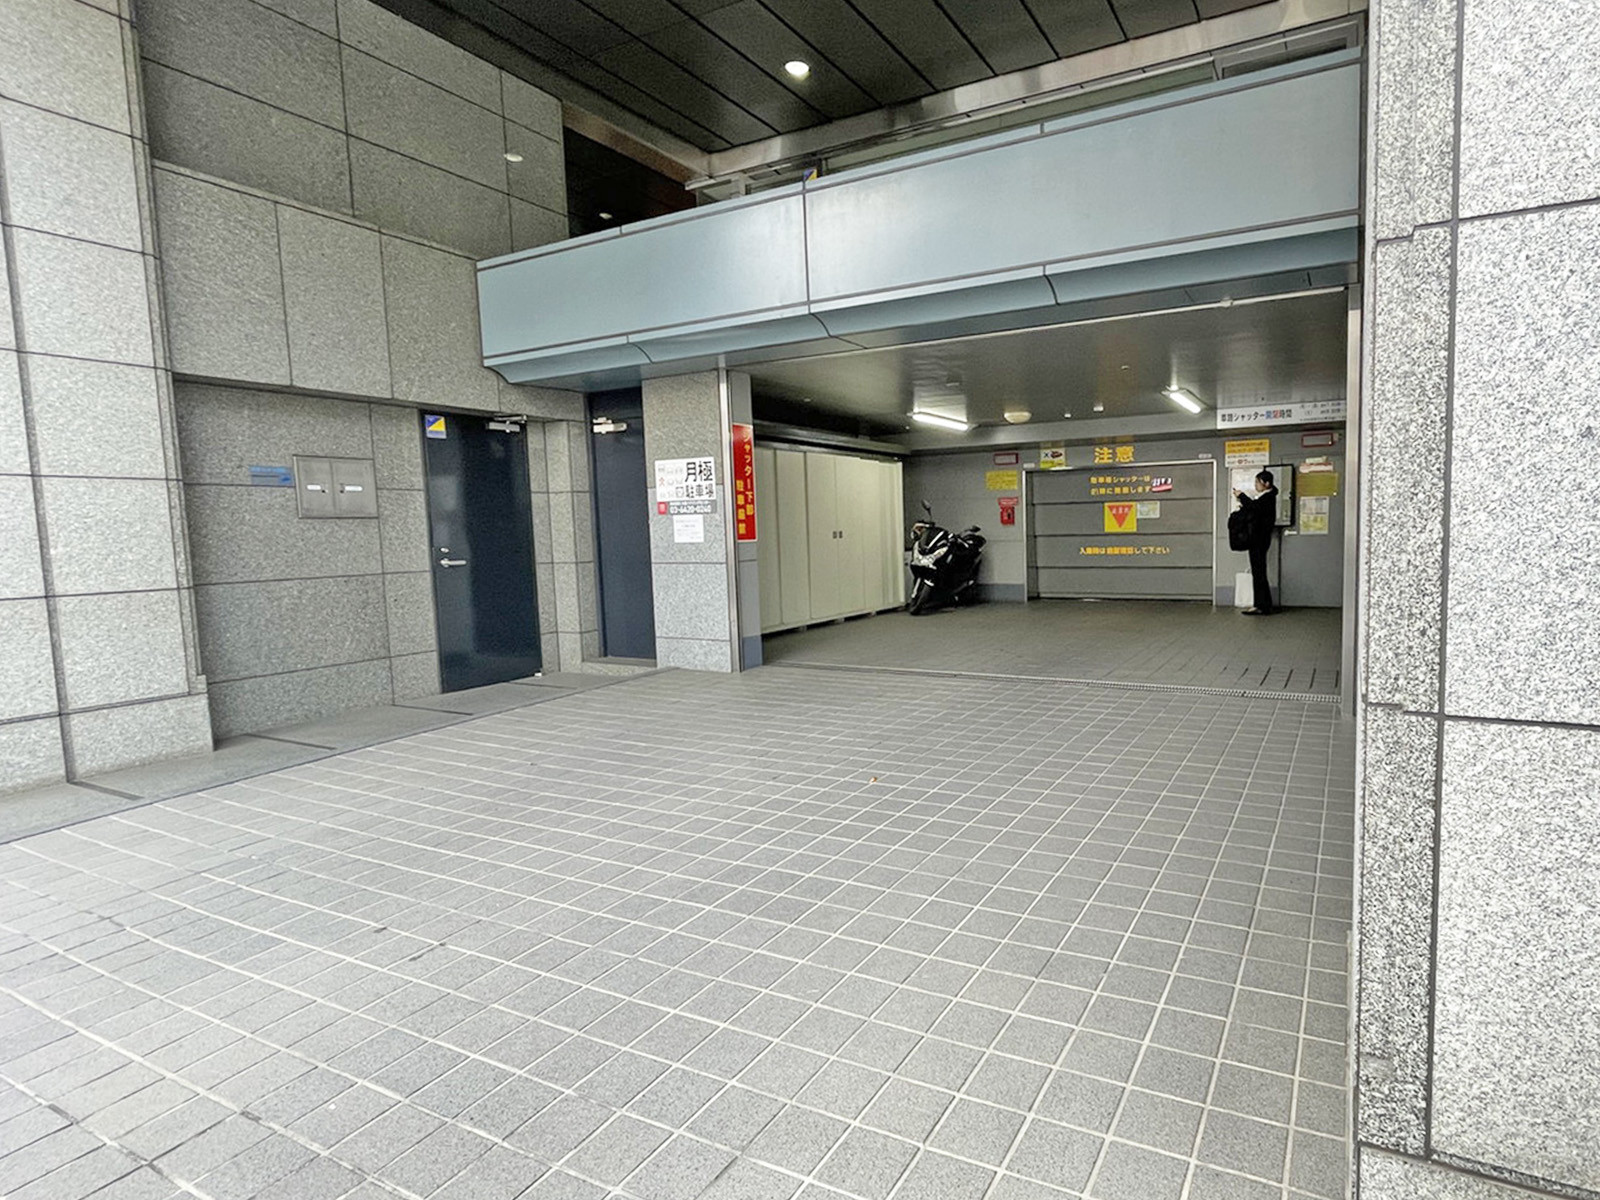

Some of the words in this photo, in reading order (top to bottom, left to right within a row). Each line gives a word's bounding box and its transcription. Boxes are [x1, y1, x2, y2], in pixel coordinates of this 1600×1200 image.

[1094, 445, 1135, 463] 注意
[684, 460, 713, 482] 月極
[685, 483, 715, 498] 駐車場
